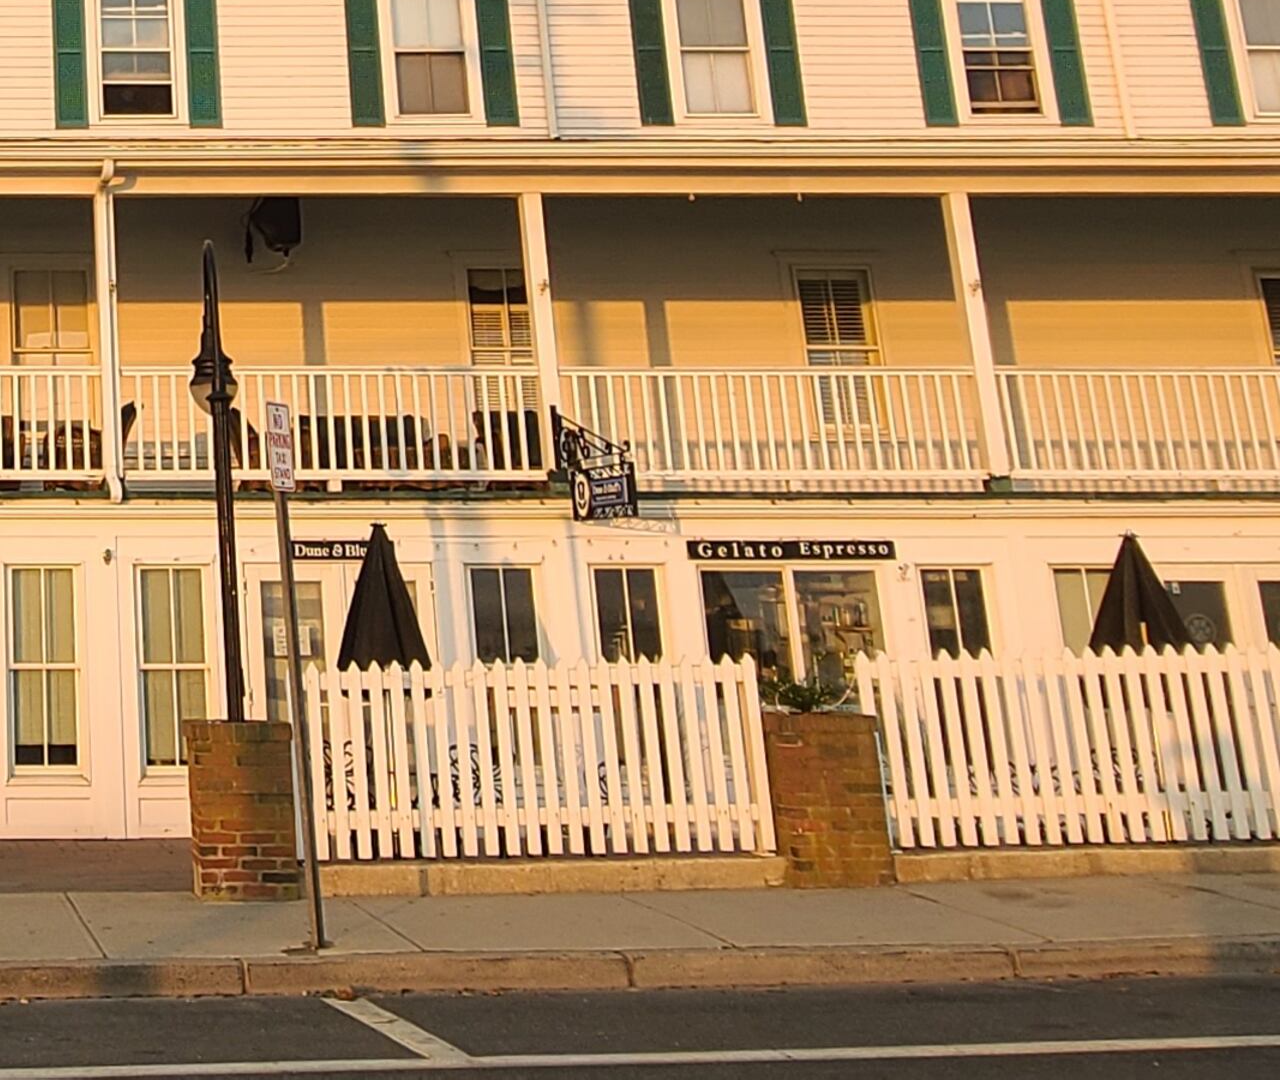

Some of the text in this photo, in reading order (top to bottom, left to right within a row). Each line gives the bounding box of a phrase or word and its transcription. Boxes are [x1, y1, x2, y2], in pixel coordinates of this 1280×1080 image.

[272, 413, 283, 430] NO
[294, 543, 368, 557] Dune & Blu
[697, 541, 889, 559] Gelato Espresso
